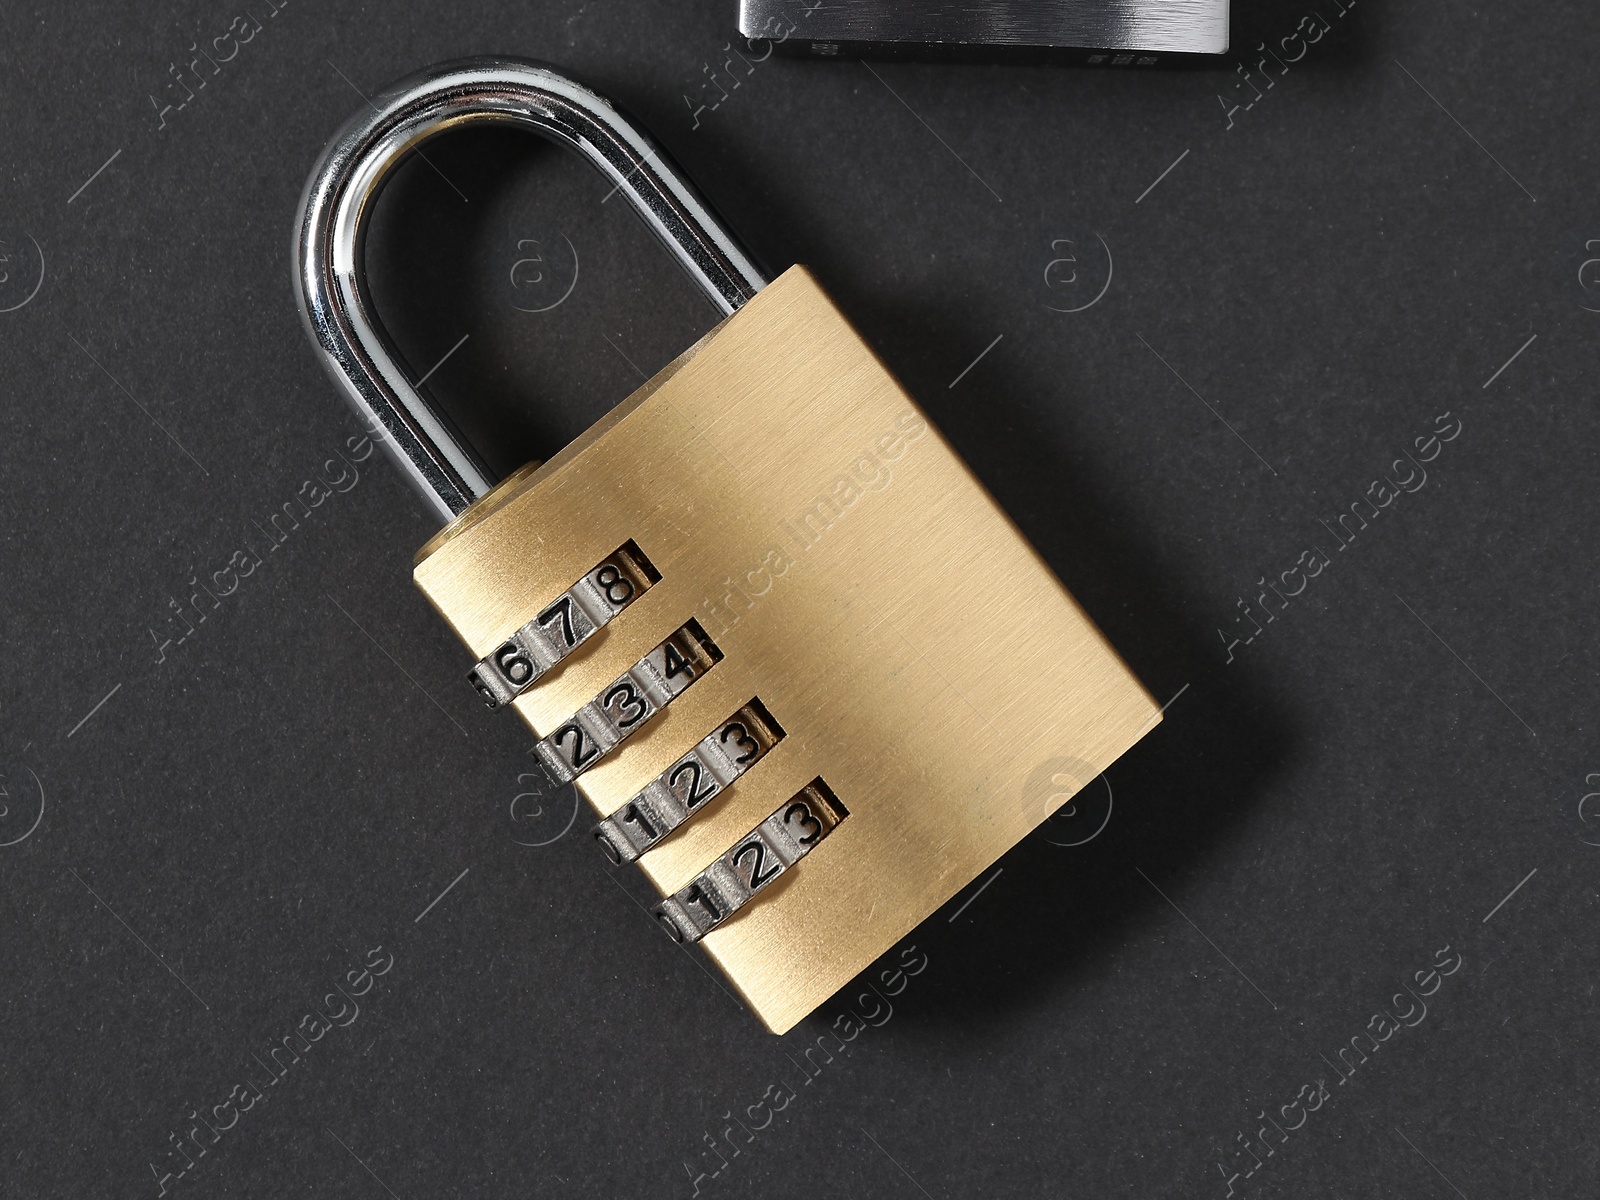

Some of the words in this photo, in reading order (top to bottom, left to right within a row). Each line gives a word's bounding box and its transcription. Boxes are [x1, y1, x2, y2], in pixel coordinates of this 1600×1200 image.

[496, 644, 533, 685] 6
[538, 596, 575, 647] 7
[595, 564, 634, 605] 8
[555, 725, 598, 769] 2
[603, 683, 648, 728] 3
[663, 642, 696, 680] 4
[622, 807, 659, 839] 1
[668, 760, 716, 808] 2
[721, 721, 760, 764] 3
[688, 886, 723, 920] 1
[732, 840, 779, 888] 2
[784, 802, 823, 845] 3
